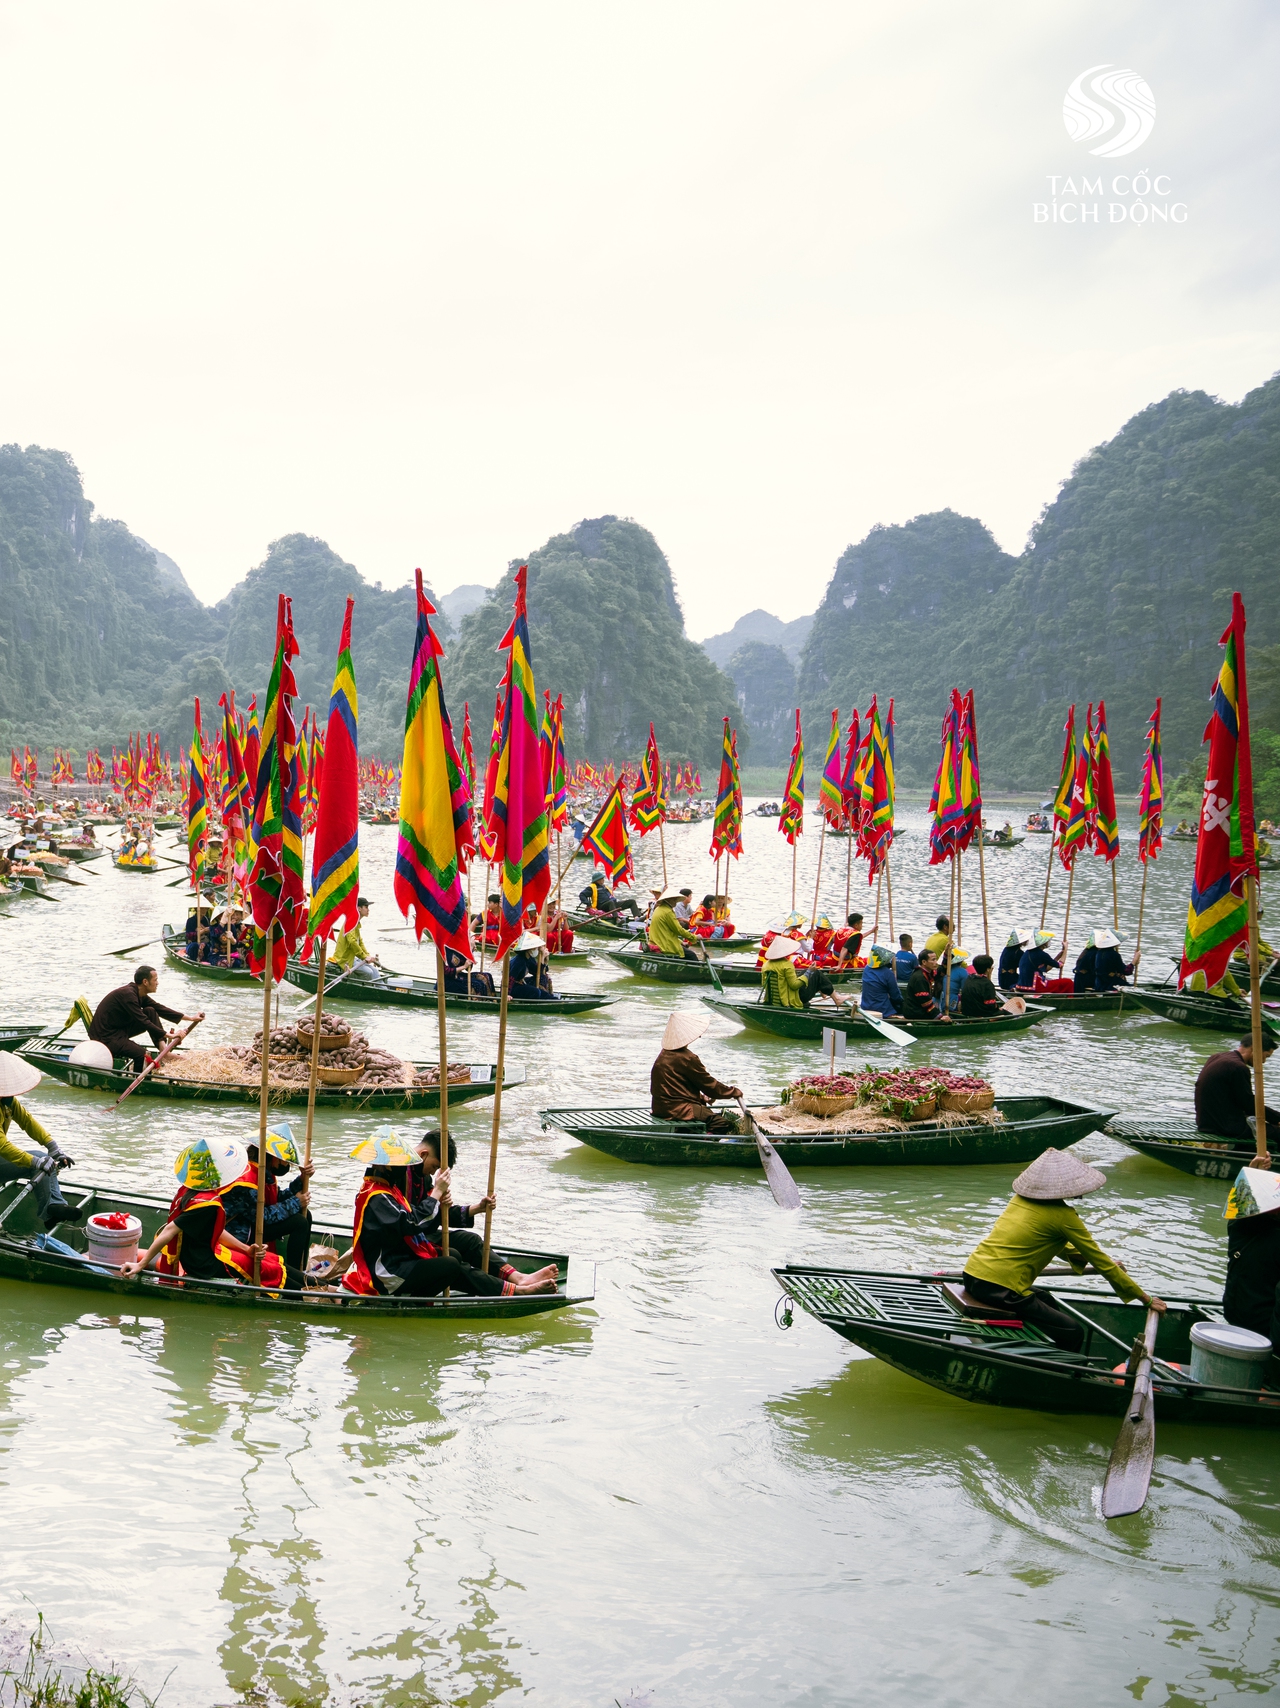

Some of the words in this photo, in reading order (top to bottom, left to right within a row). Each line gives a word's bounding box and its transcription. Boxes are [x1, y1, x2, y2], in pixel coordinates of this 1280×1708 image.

[641, 961, 658, 973] 573
[287, 970, 300, 983] 151
[1166, 1006, 1188, 1020] 788
[67, 1070, 89, 1087] 178
[1194, 1159, 1231, 1179] 348
